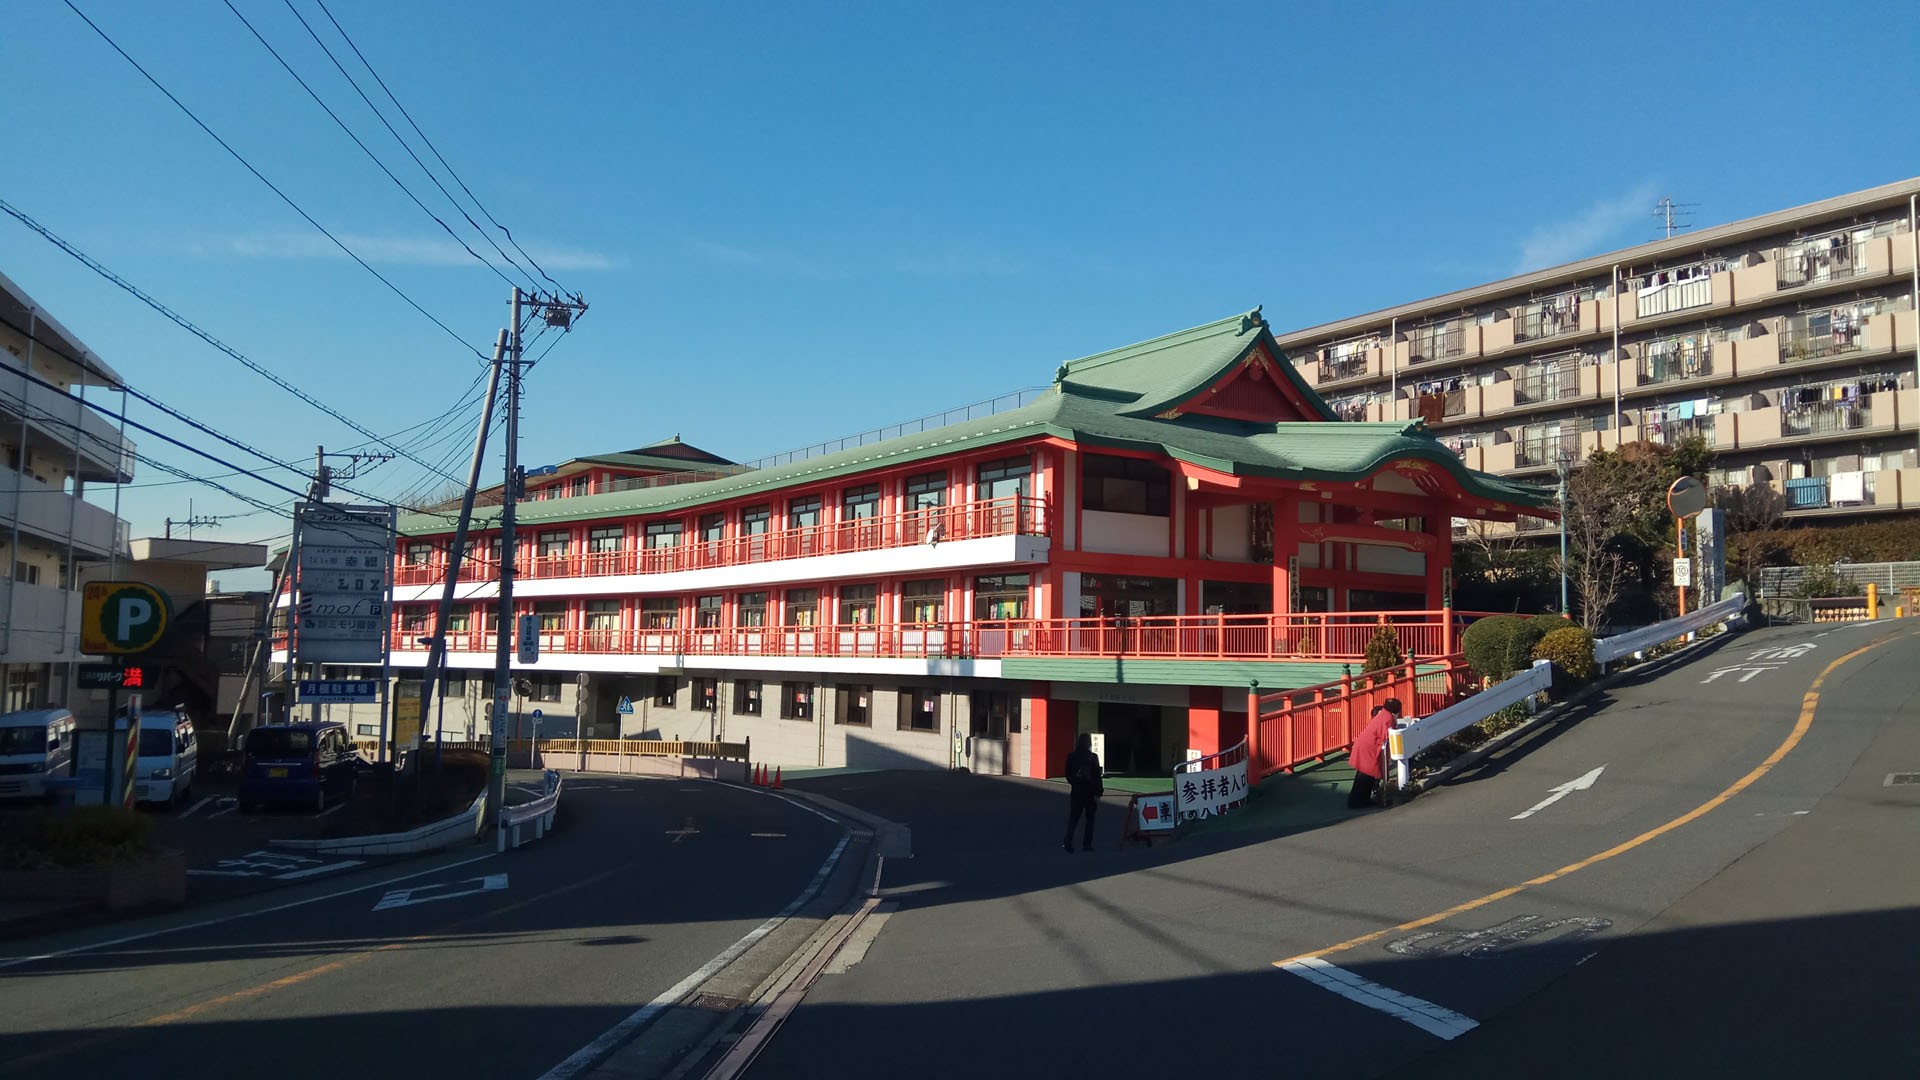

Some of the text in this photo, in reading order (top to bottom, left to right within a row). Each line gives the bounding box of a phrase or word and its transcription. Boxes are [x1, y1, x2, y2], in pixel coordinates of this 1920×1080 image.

[316, 598, 366, 615] mof
[118, 598, 152, 640] P
[123, 667, 143, 688] 満
[1182, 773, 1247, 805] 参拝者入口
[1160, 801, 1172, 821] 車
